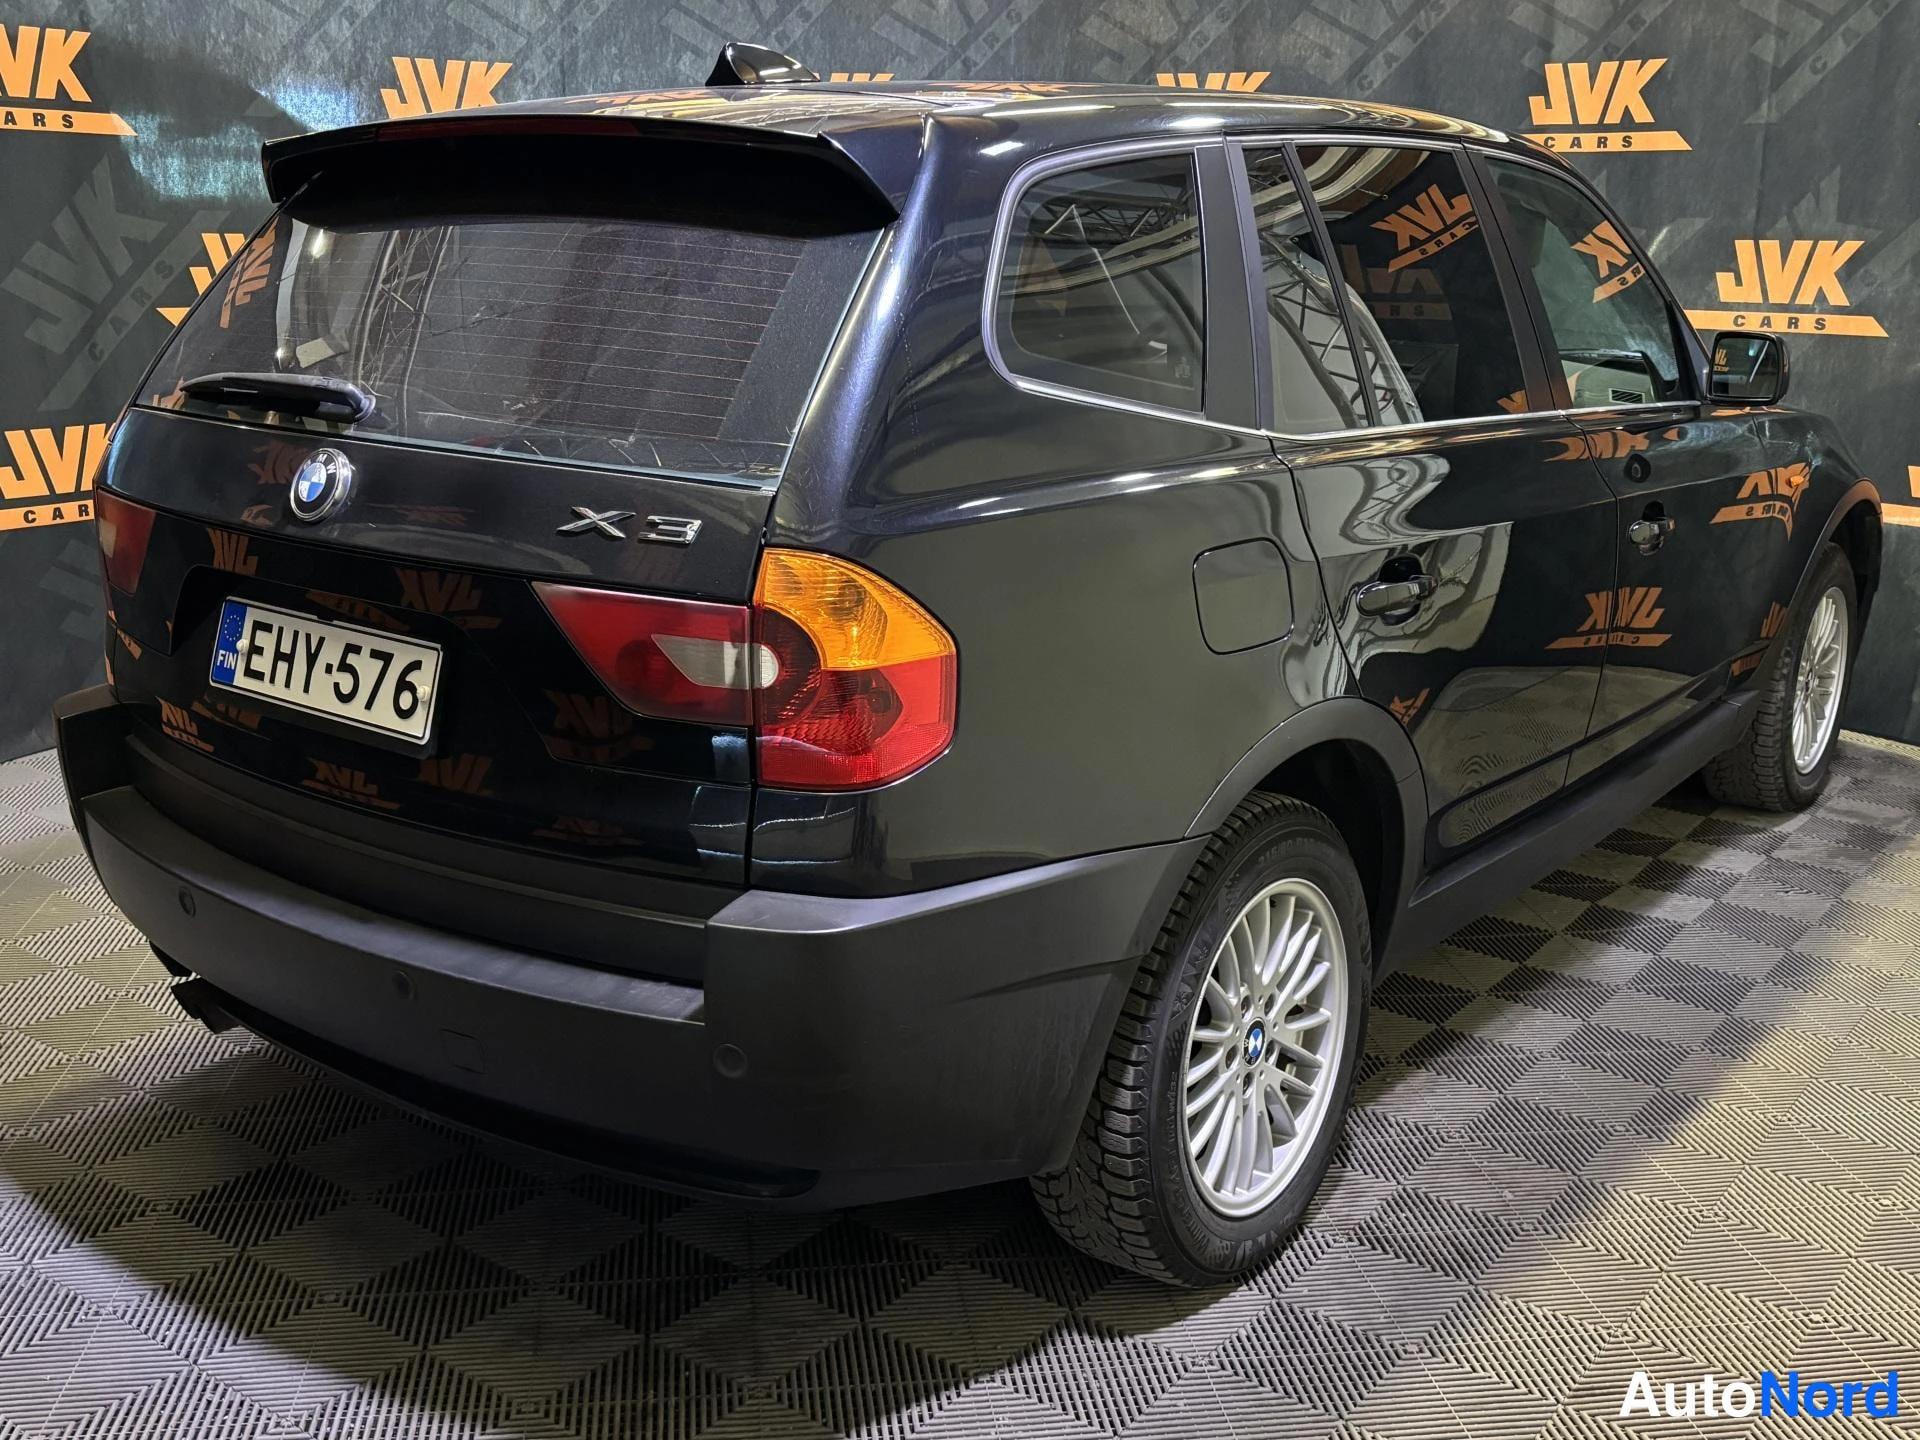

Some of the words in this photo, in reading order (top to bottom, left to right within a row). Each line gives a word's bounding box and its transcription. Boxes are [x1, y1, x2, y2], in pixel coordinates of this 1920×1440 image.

[0, 24, 93, 103] VK
[380, 57, 513, 119] JVK
[1528, 58, 1669, 126] JVK
[1544, 134, 1632, 149] CARS
[1715, 240, 1865, 306] JVK
[1733, 314, 1827, 331] CARS
[217, 650, 237, 670] FIN
[243, 619, 423, 720] EHY-576
